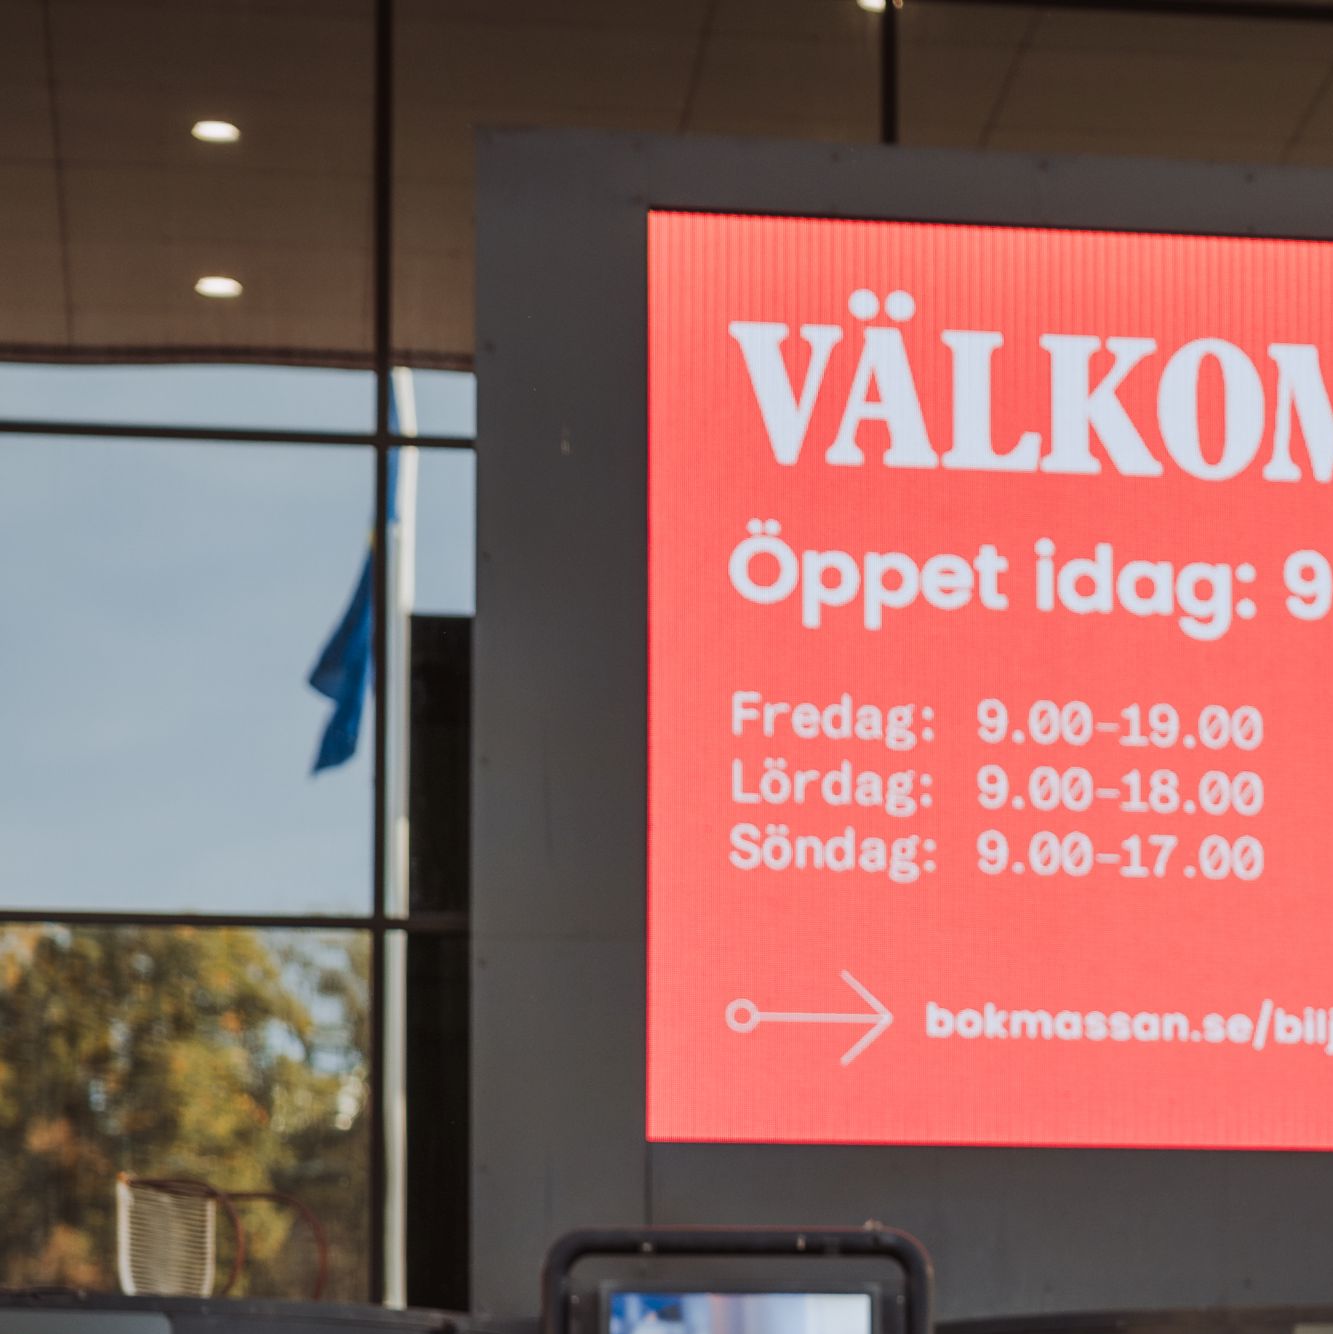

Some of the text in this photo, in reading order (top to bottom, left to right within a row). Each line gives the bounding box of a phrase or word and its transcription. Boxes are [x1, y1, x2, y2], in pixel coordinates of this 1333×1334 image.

[728, 518, 1009, 631] Öppet
[1034, 538, 1258, 641] idag:
[731, 691, 935, 750] Fredag:
[731, 757, 934, 817] Lördag:
[729, 822, 937, 883] Söndag:
